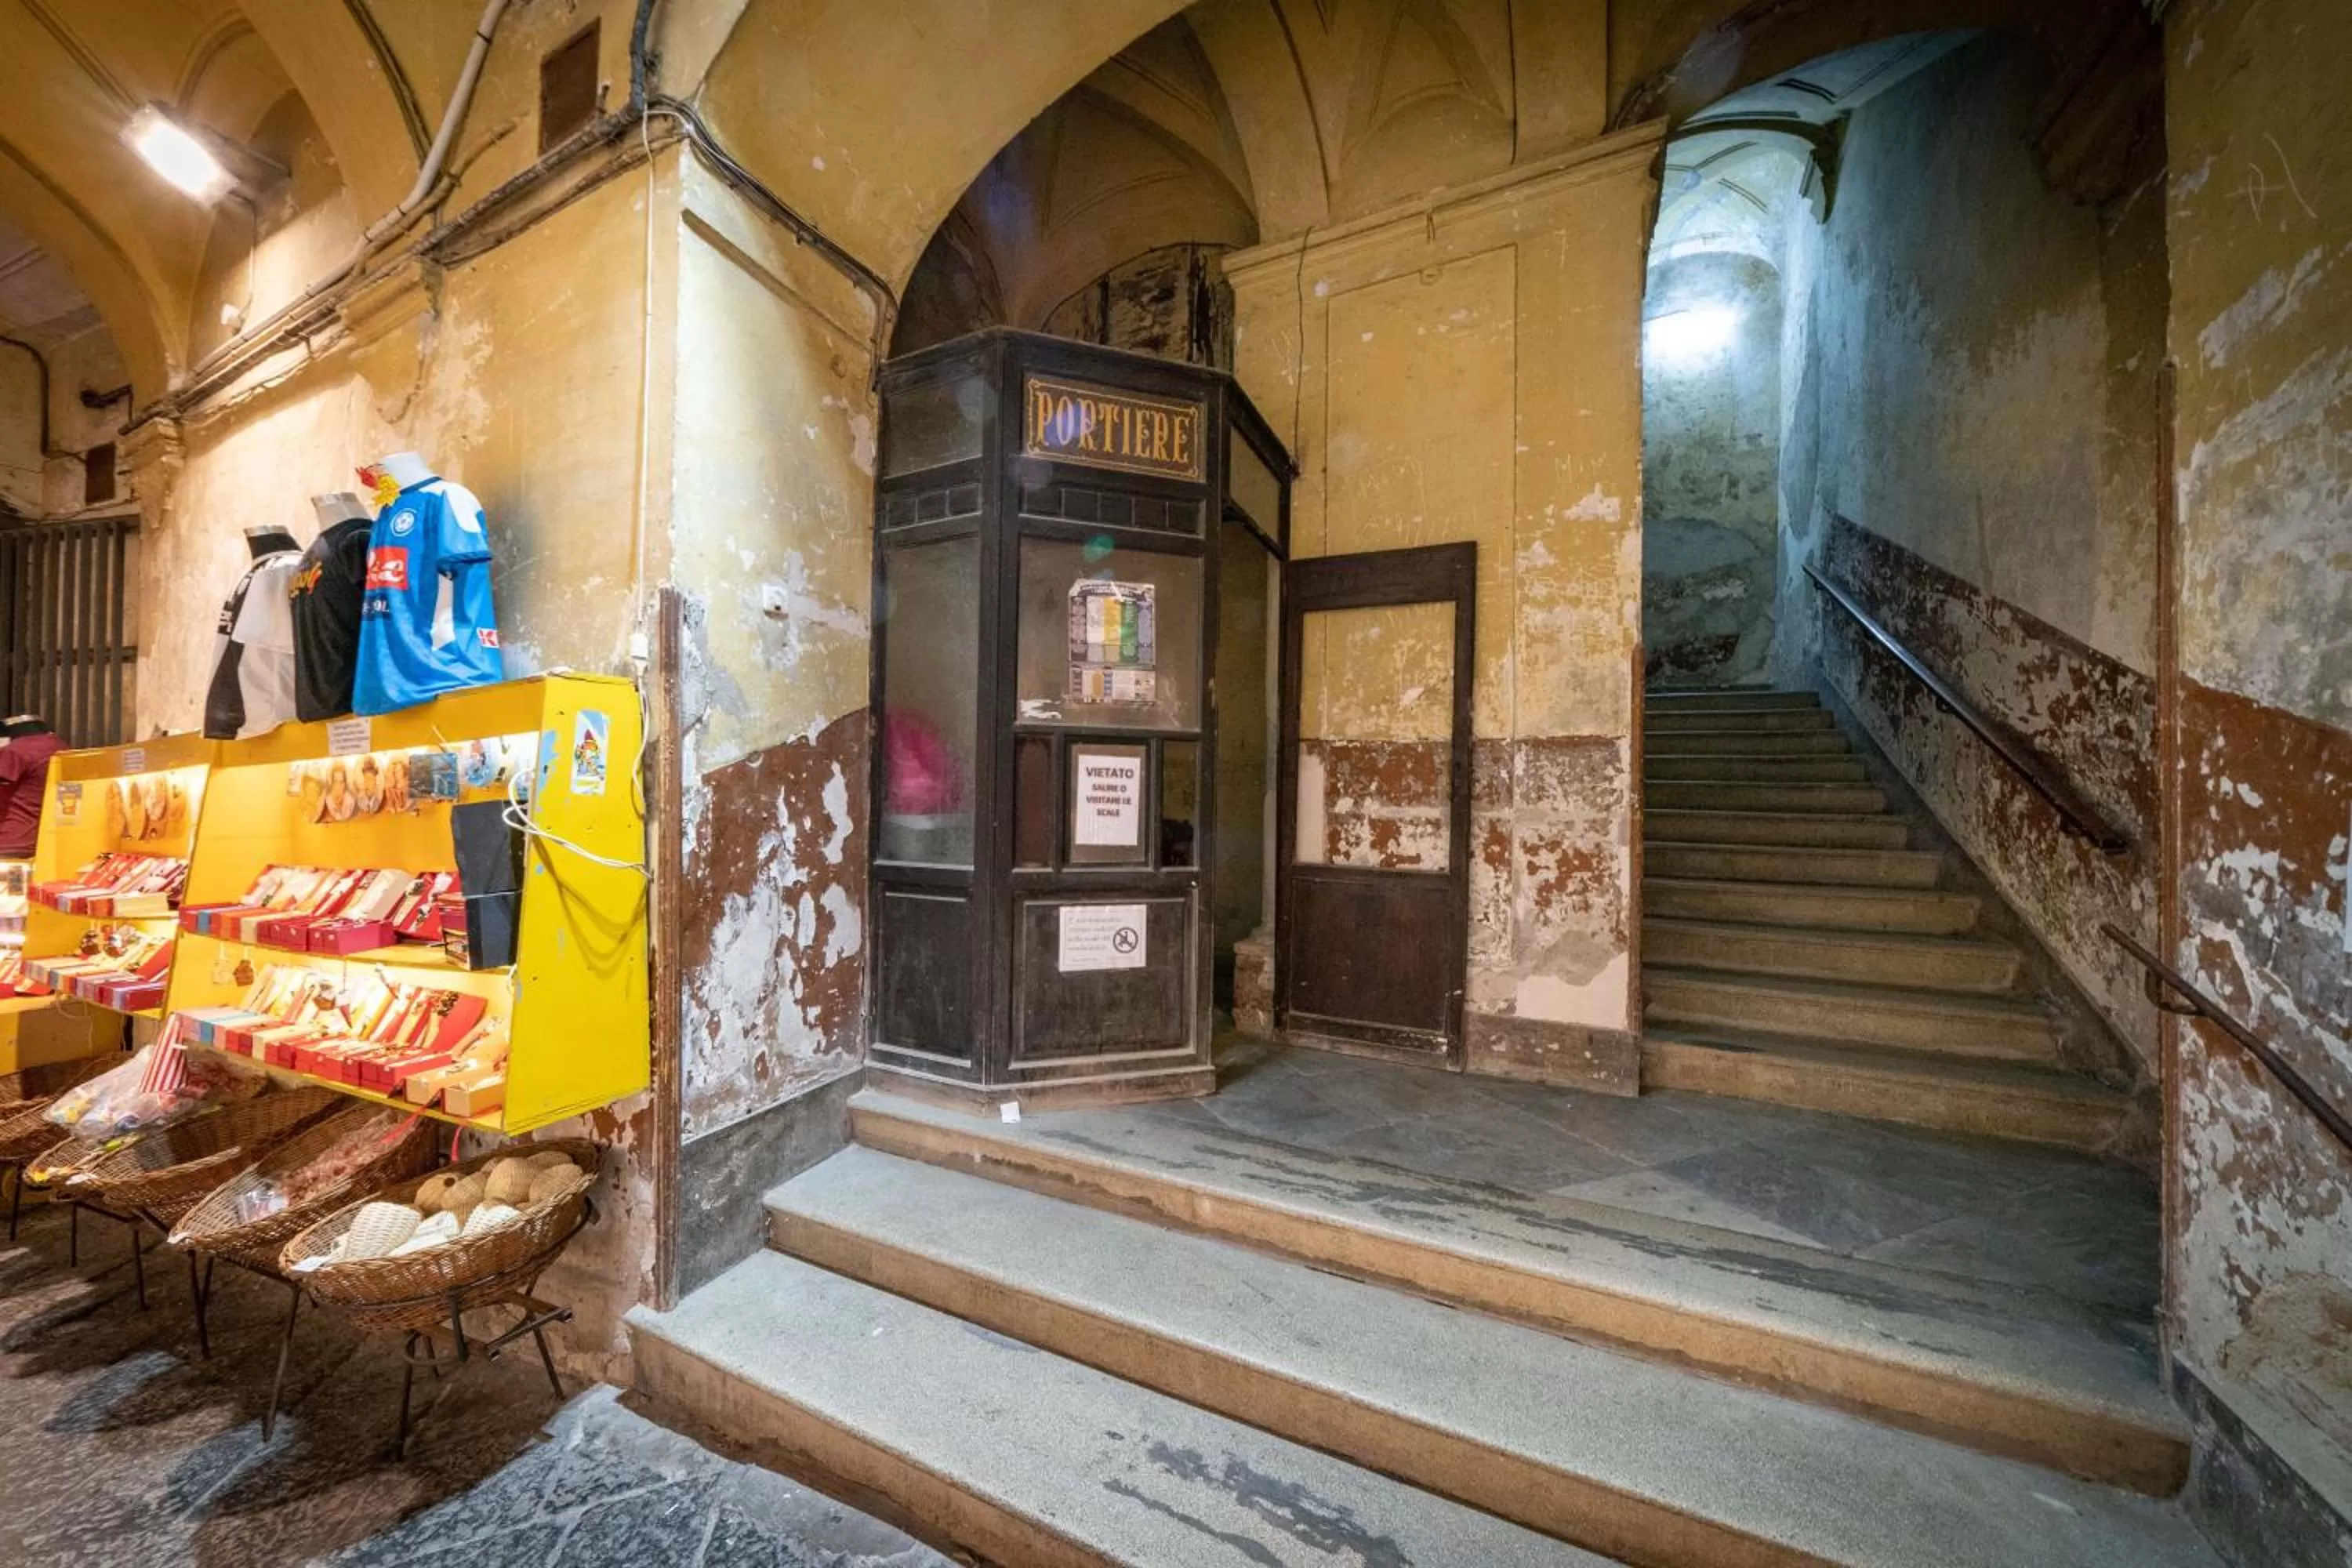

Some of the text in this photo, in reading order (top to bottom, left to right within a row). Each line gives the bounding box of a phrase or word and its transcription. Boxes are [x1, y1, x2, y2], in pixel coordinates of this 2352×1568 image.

[1035, 390, 1190, 463] PORTIERE
[1085, 766, 1134, 779] VIETATO
[1120, 784, 1127, 793] O
